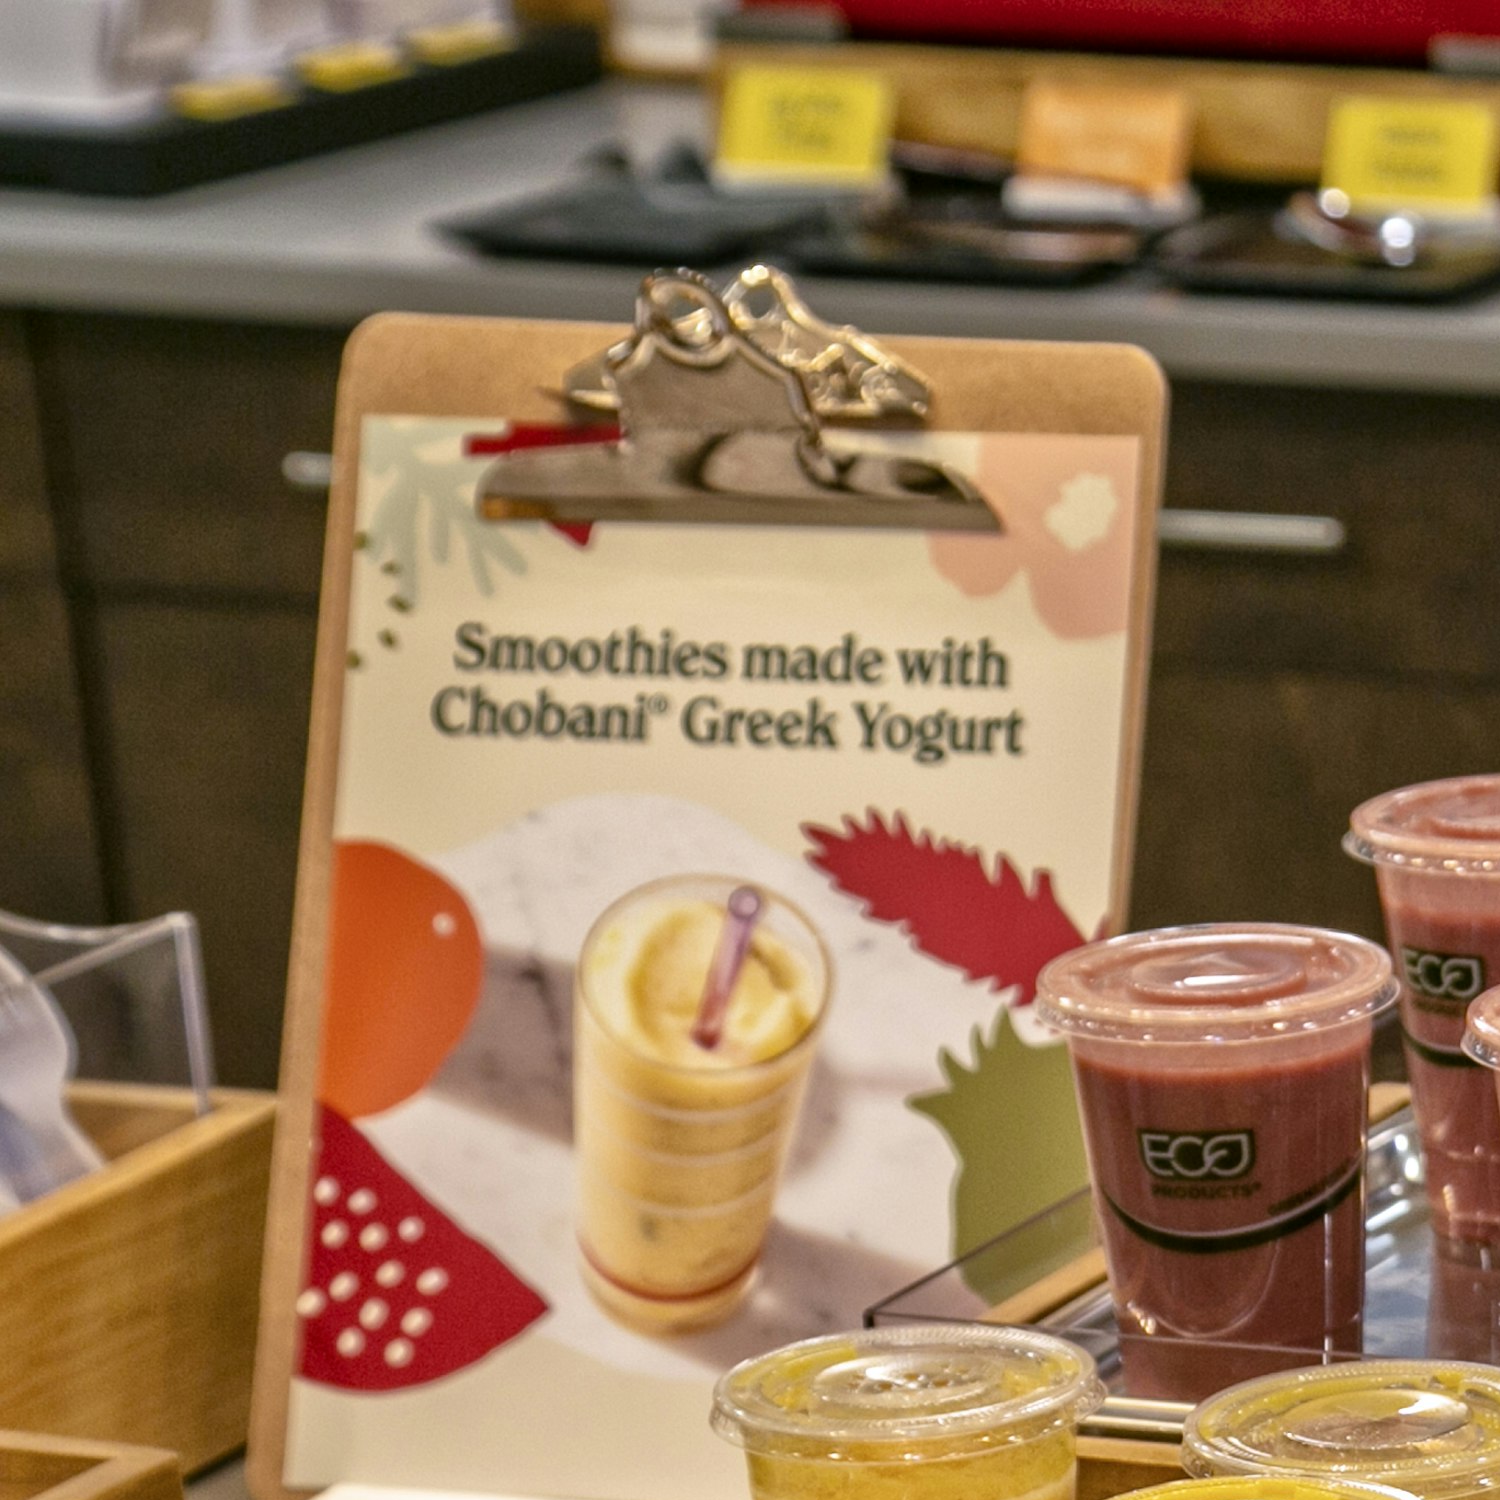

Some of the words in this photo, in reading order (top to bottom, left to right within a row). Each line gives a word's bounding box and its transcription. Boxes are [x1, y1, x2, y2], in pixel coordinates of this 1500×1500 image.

[453, 622, 728, 679] Smoothies
[741, 633, 884, 684] made
[896, 636, 1010, 688] with
[681, 695, 839, 749] Greek
[852, 700, 1025, 763] Yogurt
[1141, 1133, 1250, 1178] ECO
